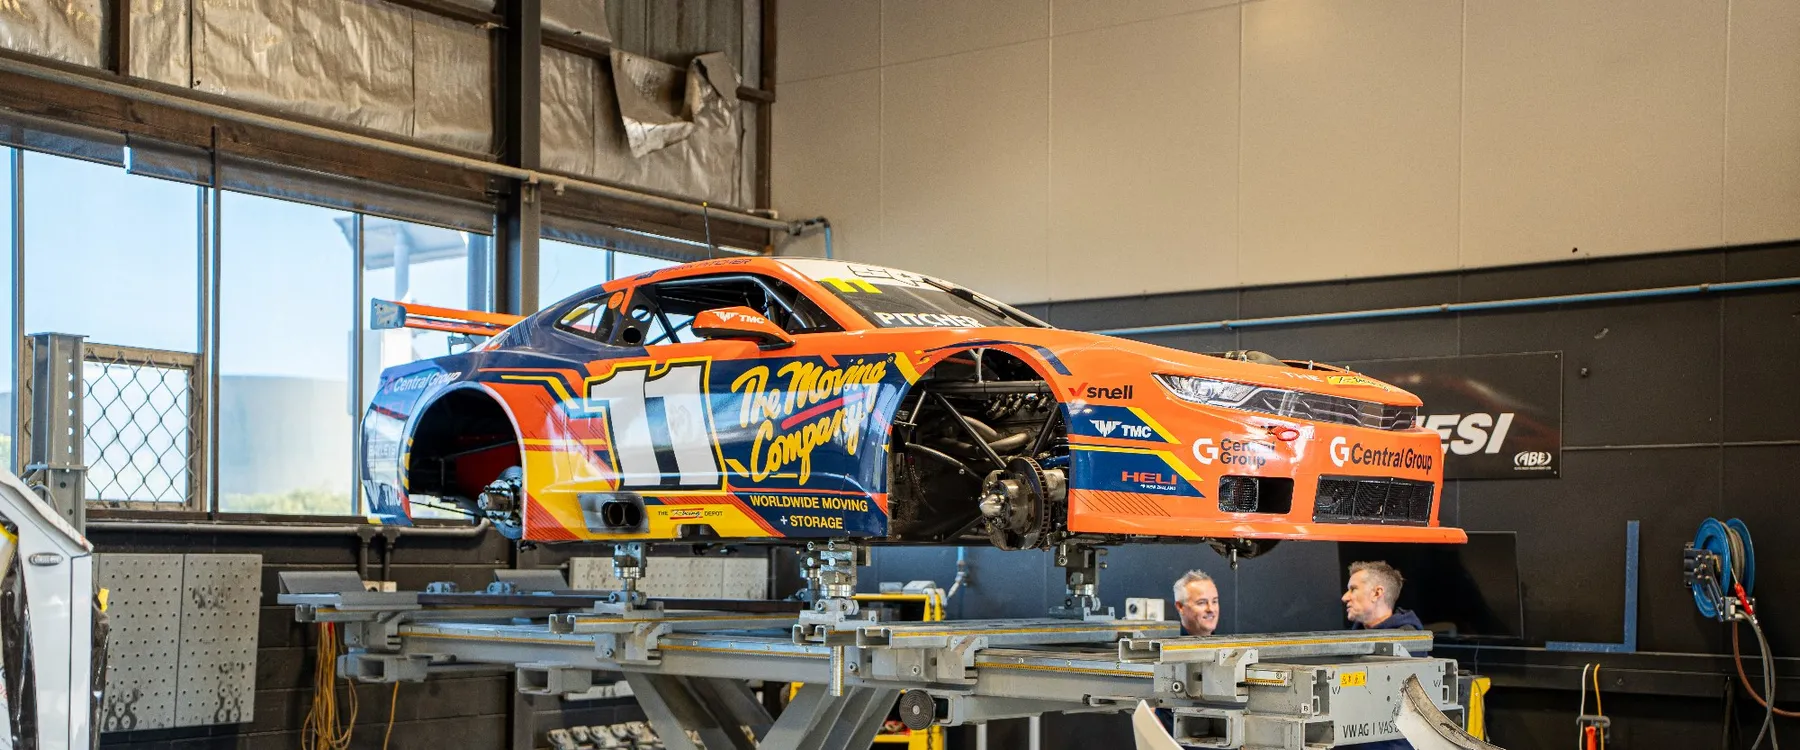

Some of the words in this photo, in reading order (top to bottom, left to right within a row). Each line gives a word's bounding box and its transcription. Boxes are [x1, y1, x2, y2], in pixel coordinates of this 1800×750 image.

[820, 278, 882, 294] 11
[739, 314, 764, 324] TMC
[874, 312, 986, 328] PITCHER
[393, 373, 431, 392] Central
[428, 371, 462, 386] Group
[731, 365, 782, 428] The
[777, 358, 886, 415] Moving
[1086, 385, 1133, 400] snell
[587, 360, 723, 489] 11
[1121, 425, 1152, 438] TMC
[751, 401, 866, 485] Company
[1220, 452, 1267, 468] Group
[1351, 443, 1405, 468] Central
[1404, 447, 1433, 475] Group
[1121, 471, 1177, 485] HELI
[750, 495, 819, 509] WORLDWIDE
[821, 498, 869, 512] MOVING
[790, 515, 843, 530] STORAGE
